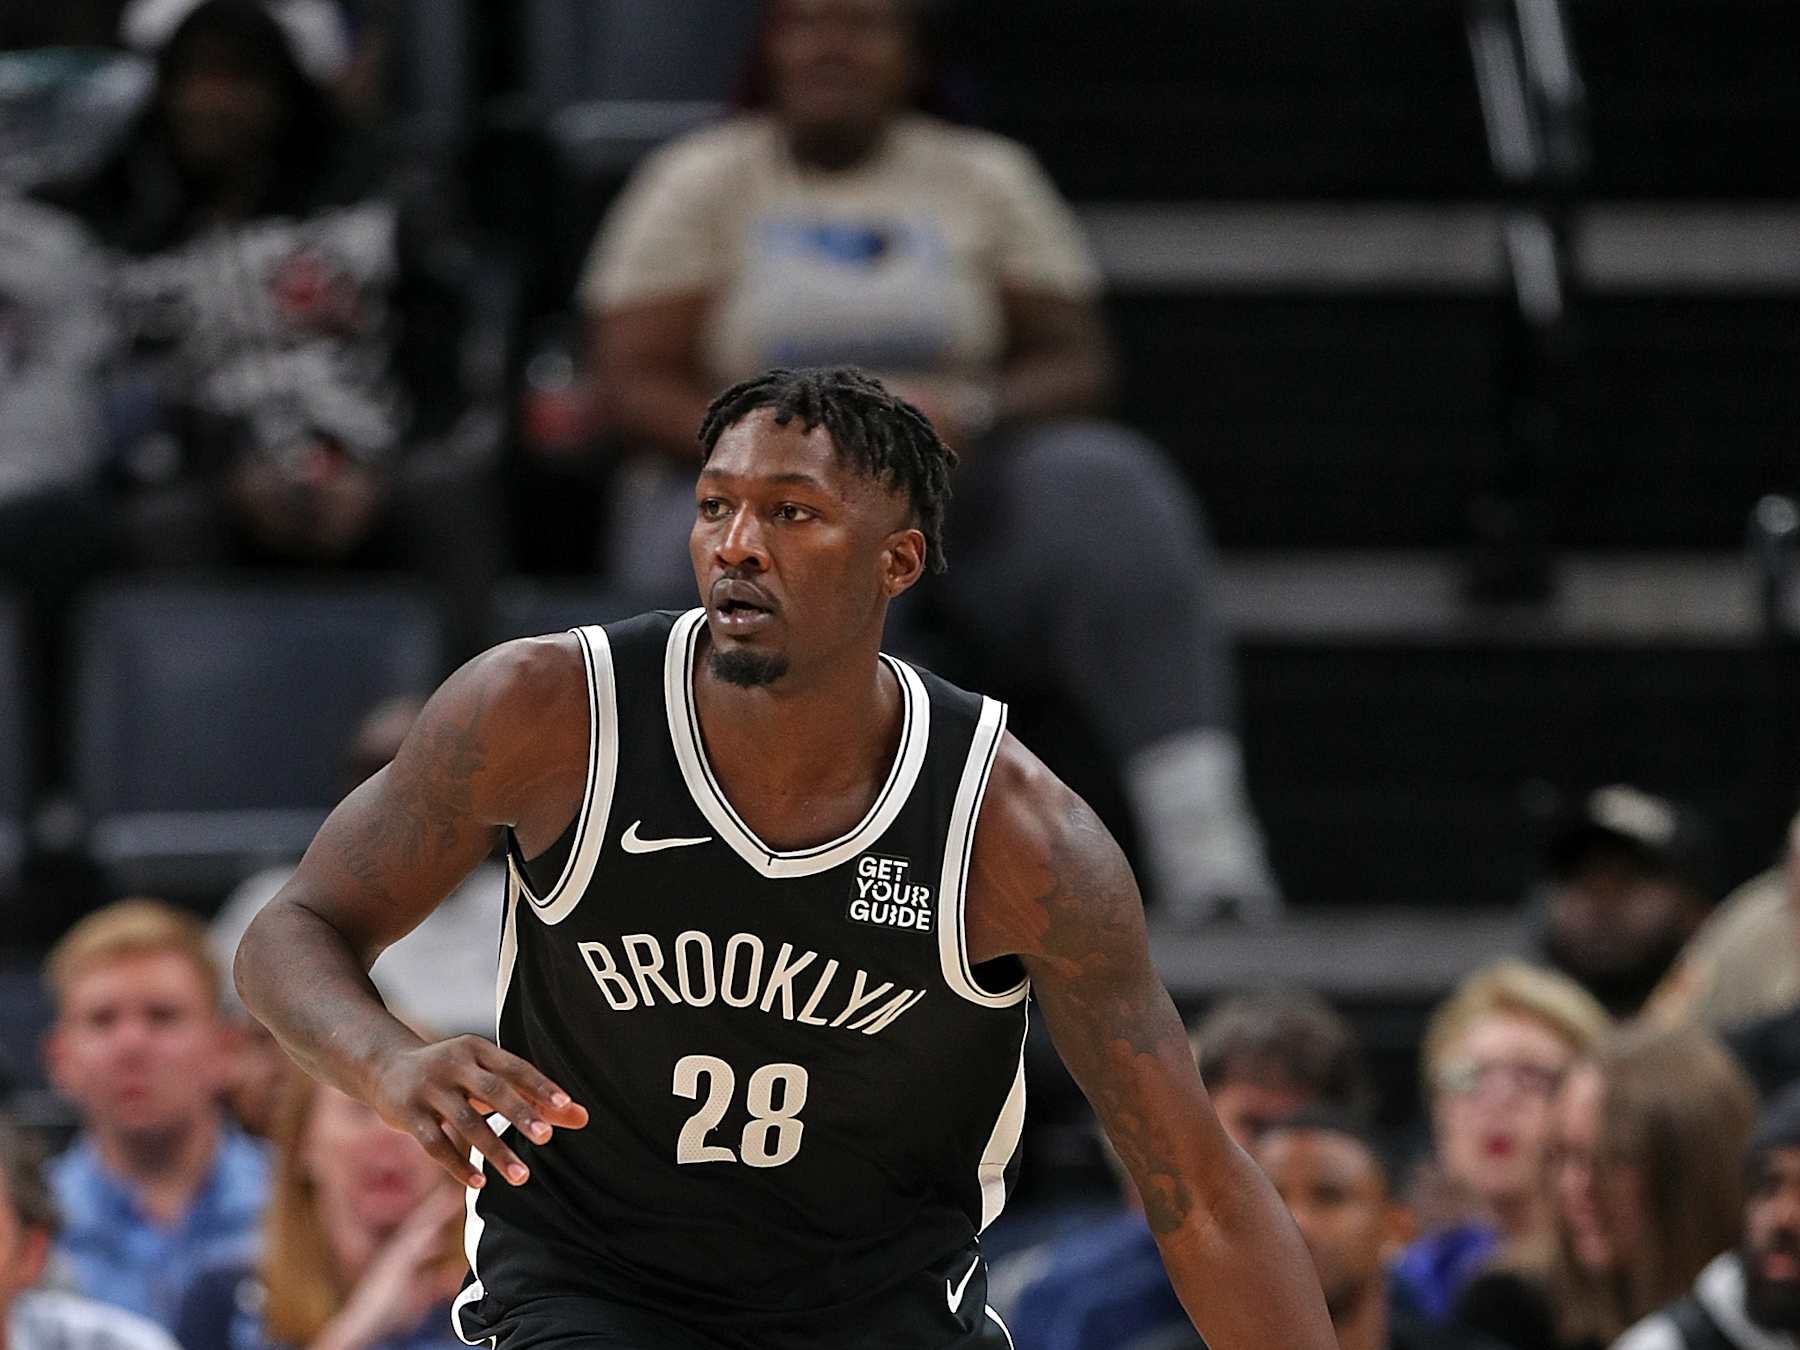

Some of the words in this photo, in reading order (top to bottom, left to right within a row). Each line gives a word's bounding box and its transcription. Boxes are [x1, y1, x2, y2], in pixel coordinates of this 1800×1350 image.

[858, 856, 909, 882] GET
[856, 877, 930, 908] YOUR
[850, 899, 932, 931] GUIDE
[577, 930, 927, 1035] BROOKLYN
[672, 1054, 809, 1168] 28
